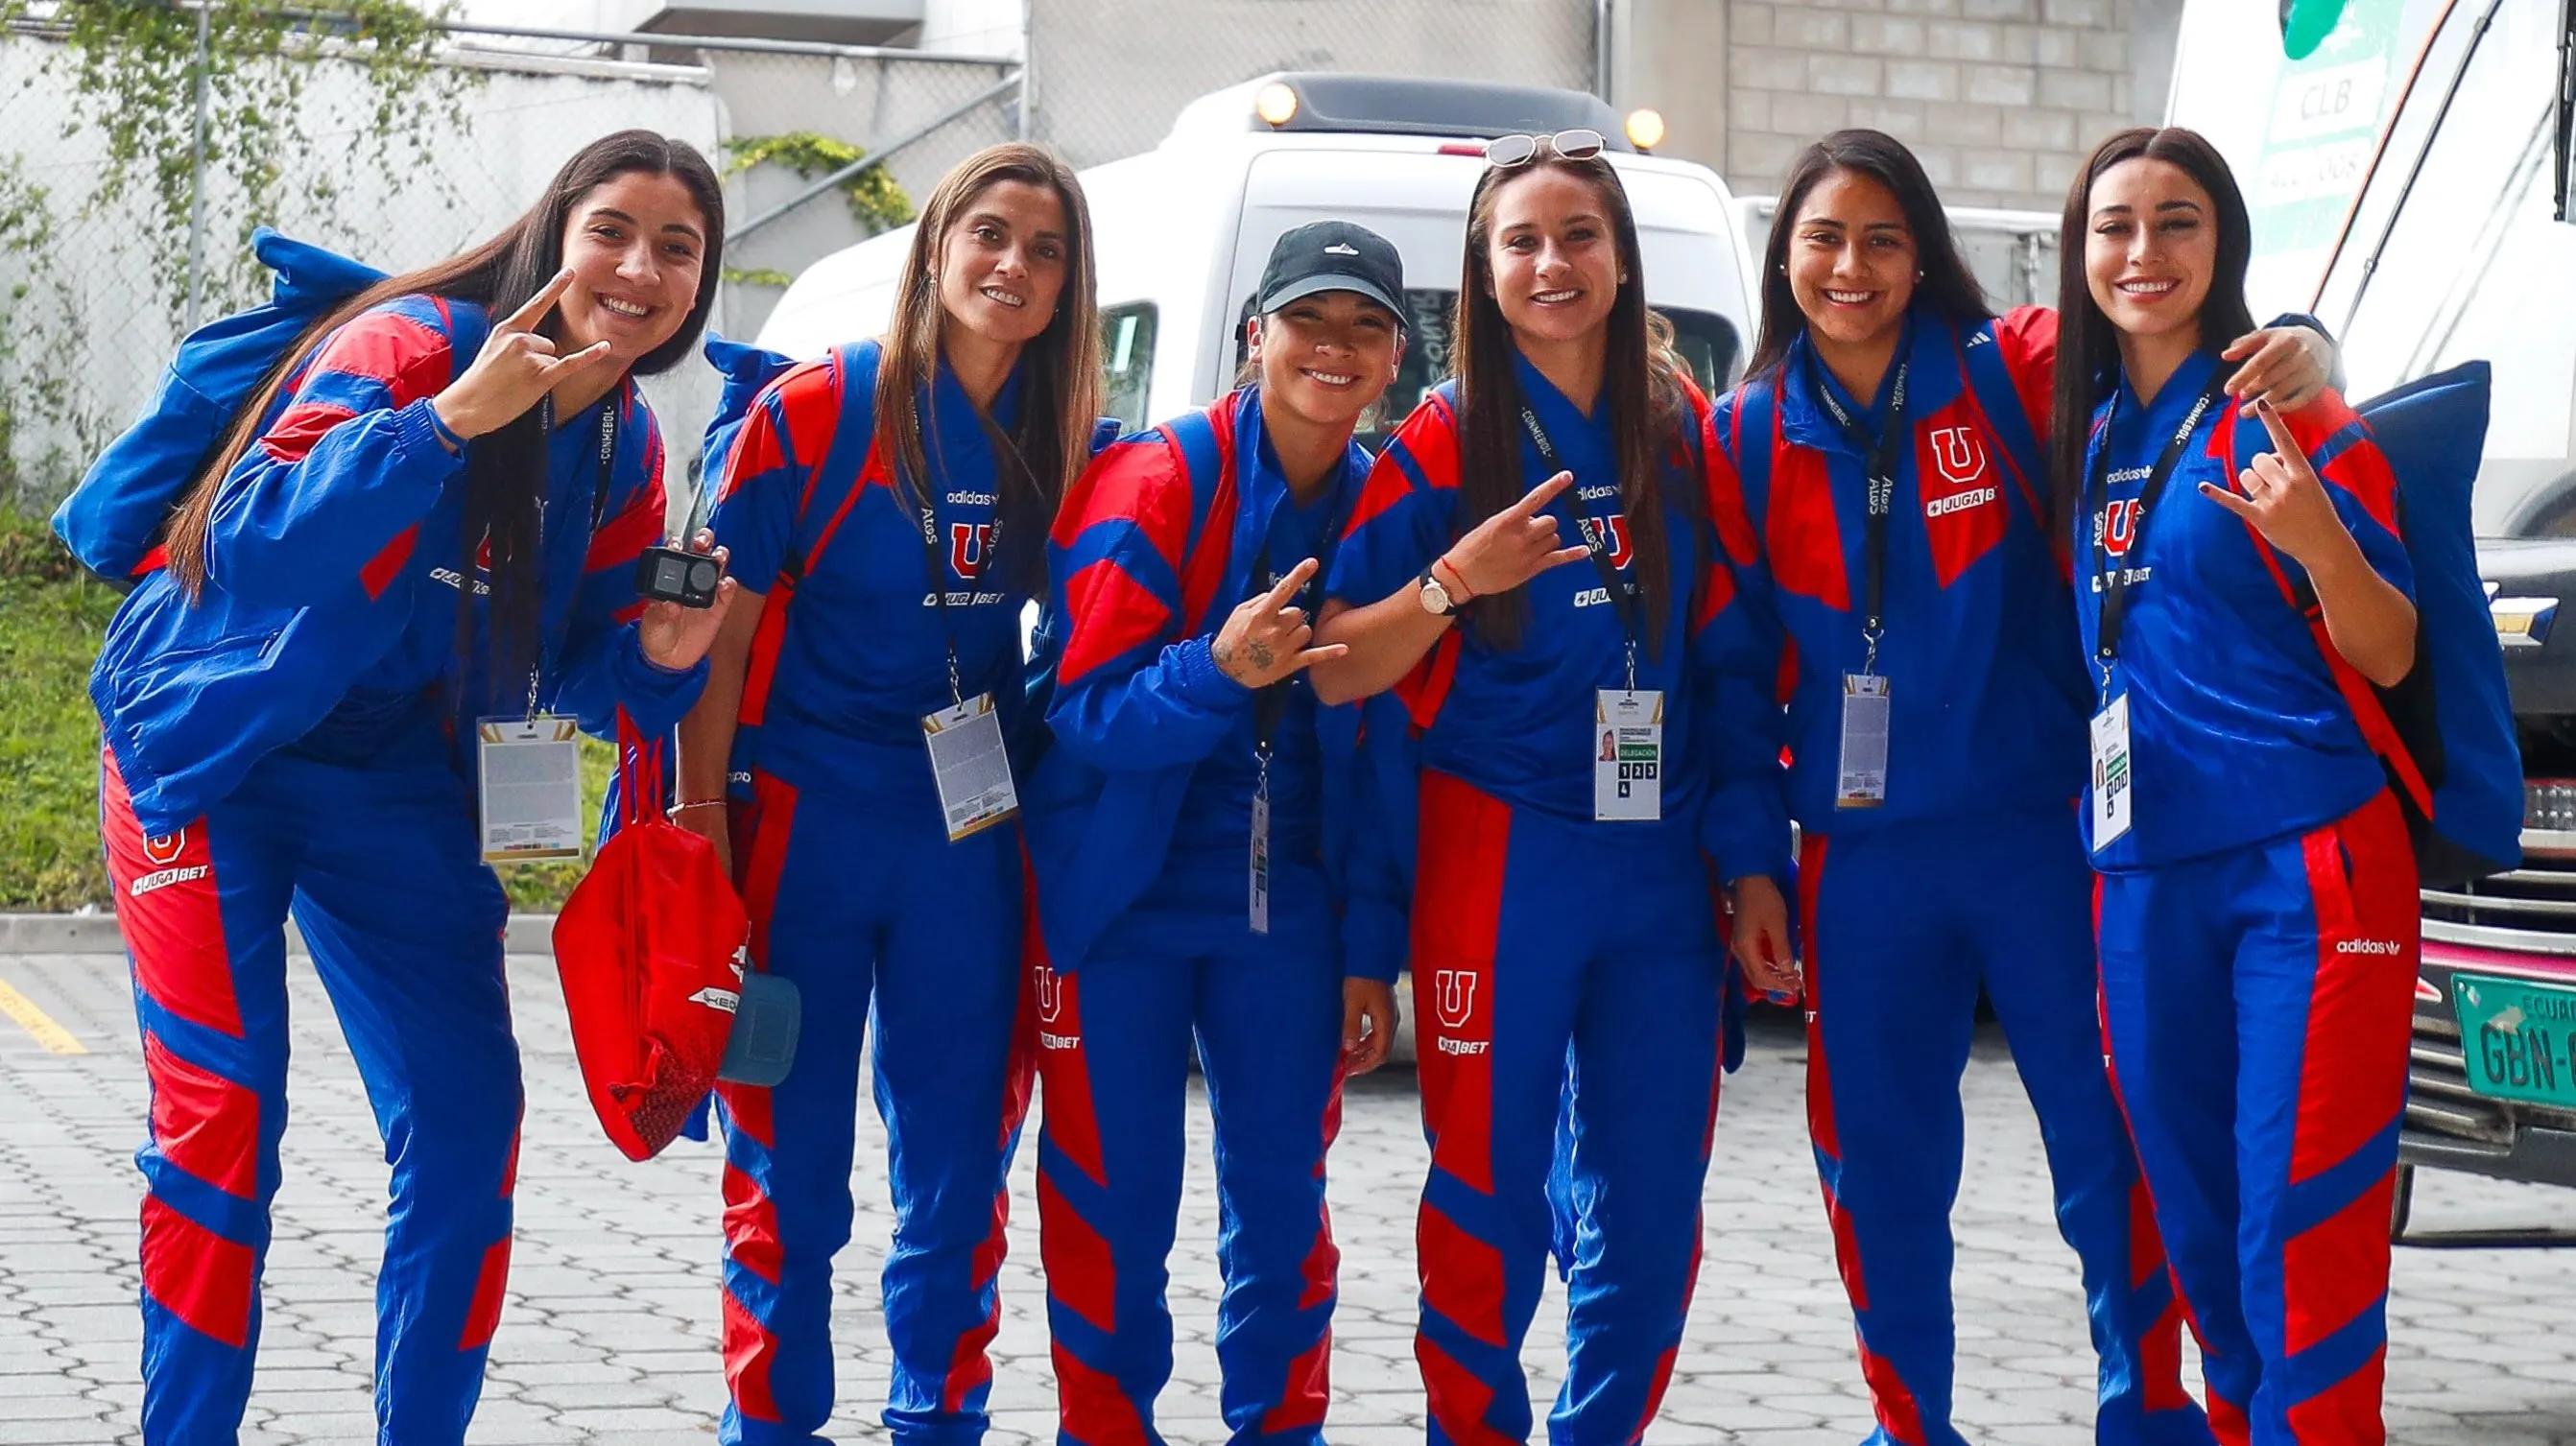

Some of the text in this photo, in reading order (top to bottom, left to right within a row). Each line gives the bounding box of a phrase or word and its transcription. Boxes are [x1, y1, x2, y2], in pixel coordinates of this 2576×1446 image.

[2301, 79, 2352, 120] CLB
[600, 410, 615, 461] CONMEBOL
[2107, 467, 2141, 484] adidas
[946, 490, 991, 506] adidas
[2104, 498, 2139, 557] U
[951, 523, 991, 580] U
[1620, 783, 1628, 794] 4
[1634, 766, 1641, 776] 2
[1648, 766, 1655, 776] 3
[2336, 938, 2386, 954] adidas
[1035, 965, 1062, 1023] U
[1436, 970, 1477, 1028] U
